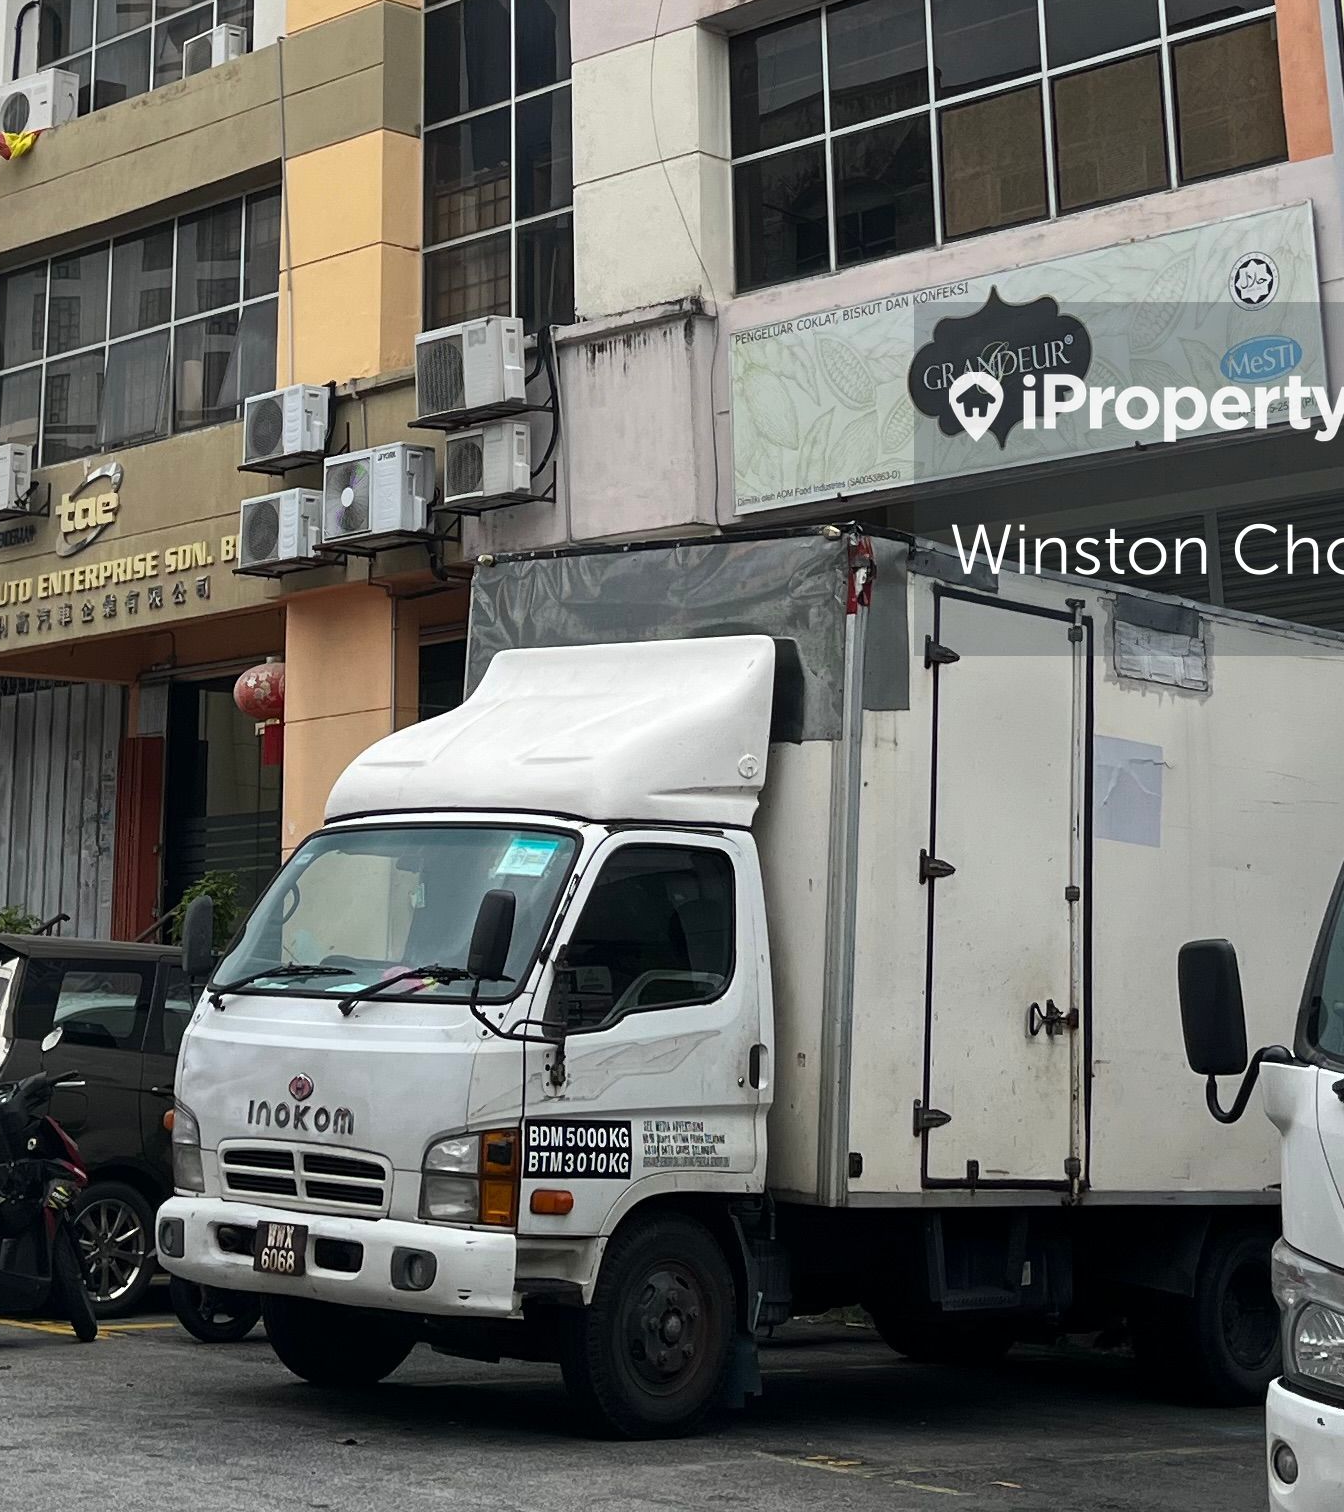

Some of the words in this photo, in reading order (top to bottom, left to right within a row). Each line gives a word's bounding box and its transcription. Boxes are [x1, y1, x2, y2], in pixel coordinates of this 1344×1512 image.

[735, 322, 794, 345] PENGELUAR
[797, 312, 839, 332] COKLAT,
[842, 302, 883, 321] BISKUT
[886, 296, 909, 312] DAN
[913, 282, 969, 304] KONFEKSI
[1228, 343, 1295, 378] MeSTI
[56, 492, 120, 533] tae
[37, 551, 159, 599] ENTERPRISE
[164, 541, 214, 573] SDN.
[247, 1099, 354, 1136] INOKOM
[529, 1126, 563, 1147] BDM
[528, 1151, 563, 1172] BTM
[261, 1247, 295, 1273] 6068
